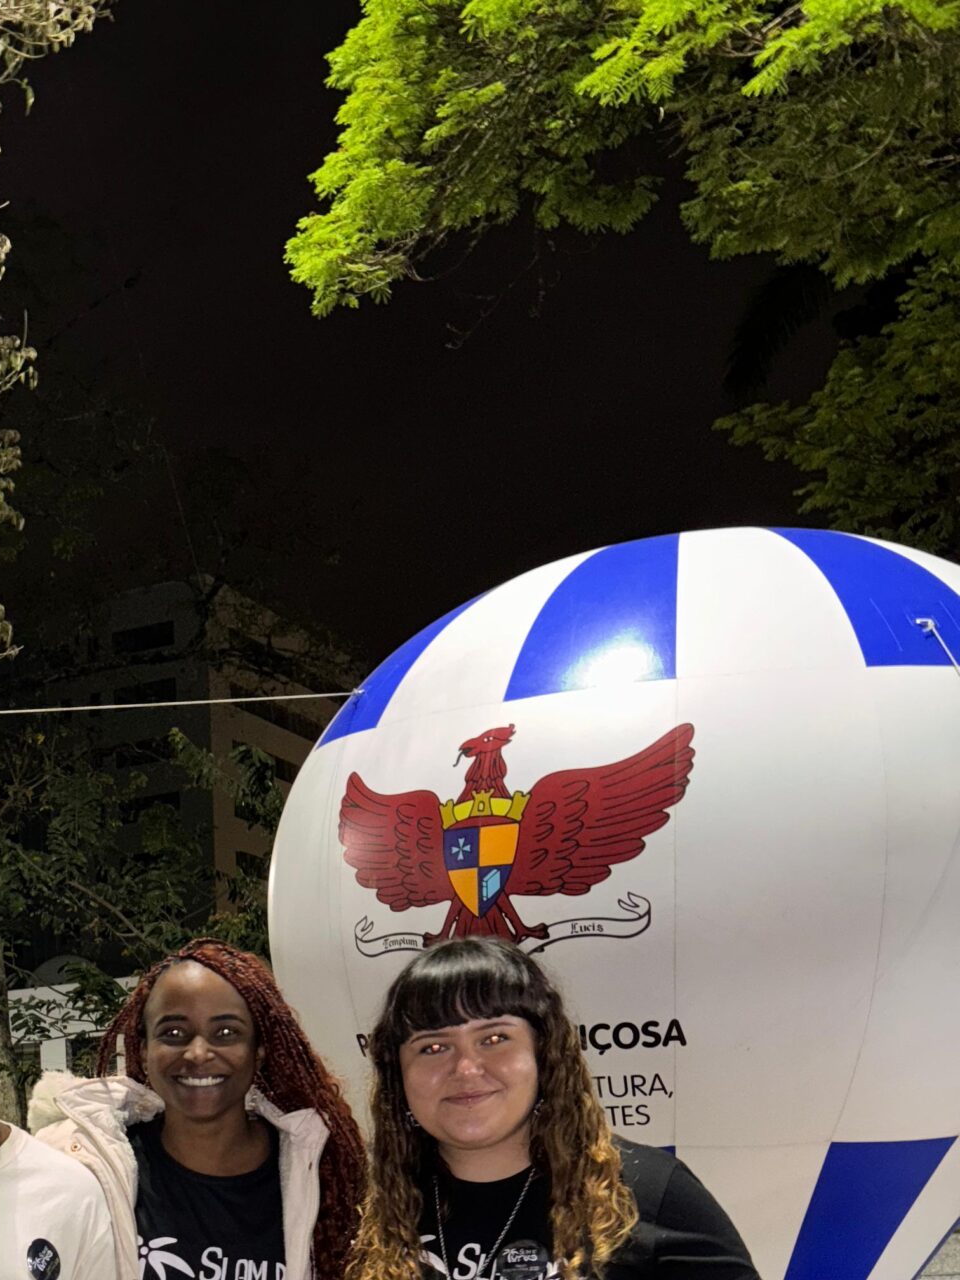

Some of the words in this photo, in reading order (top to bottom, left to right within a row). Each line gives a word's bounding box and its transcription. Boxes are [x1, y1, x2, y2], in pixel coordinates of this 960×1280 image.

[382, 937, 418, 950] Templum
[570, 922, 604, 934] Lucis
[580, 1019, 687, 1055] IÇOSA
[591, 1073, 674, 1099] TURA,
